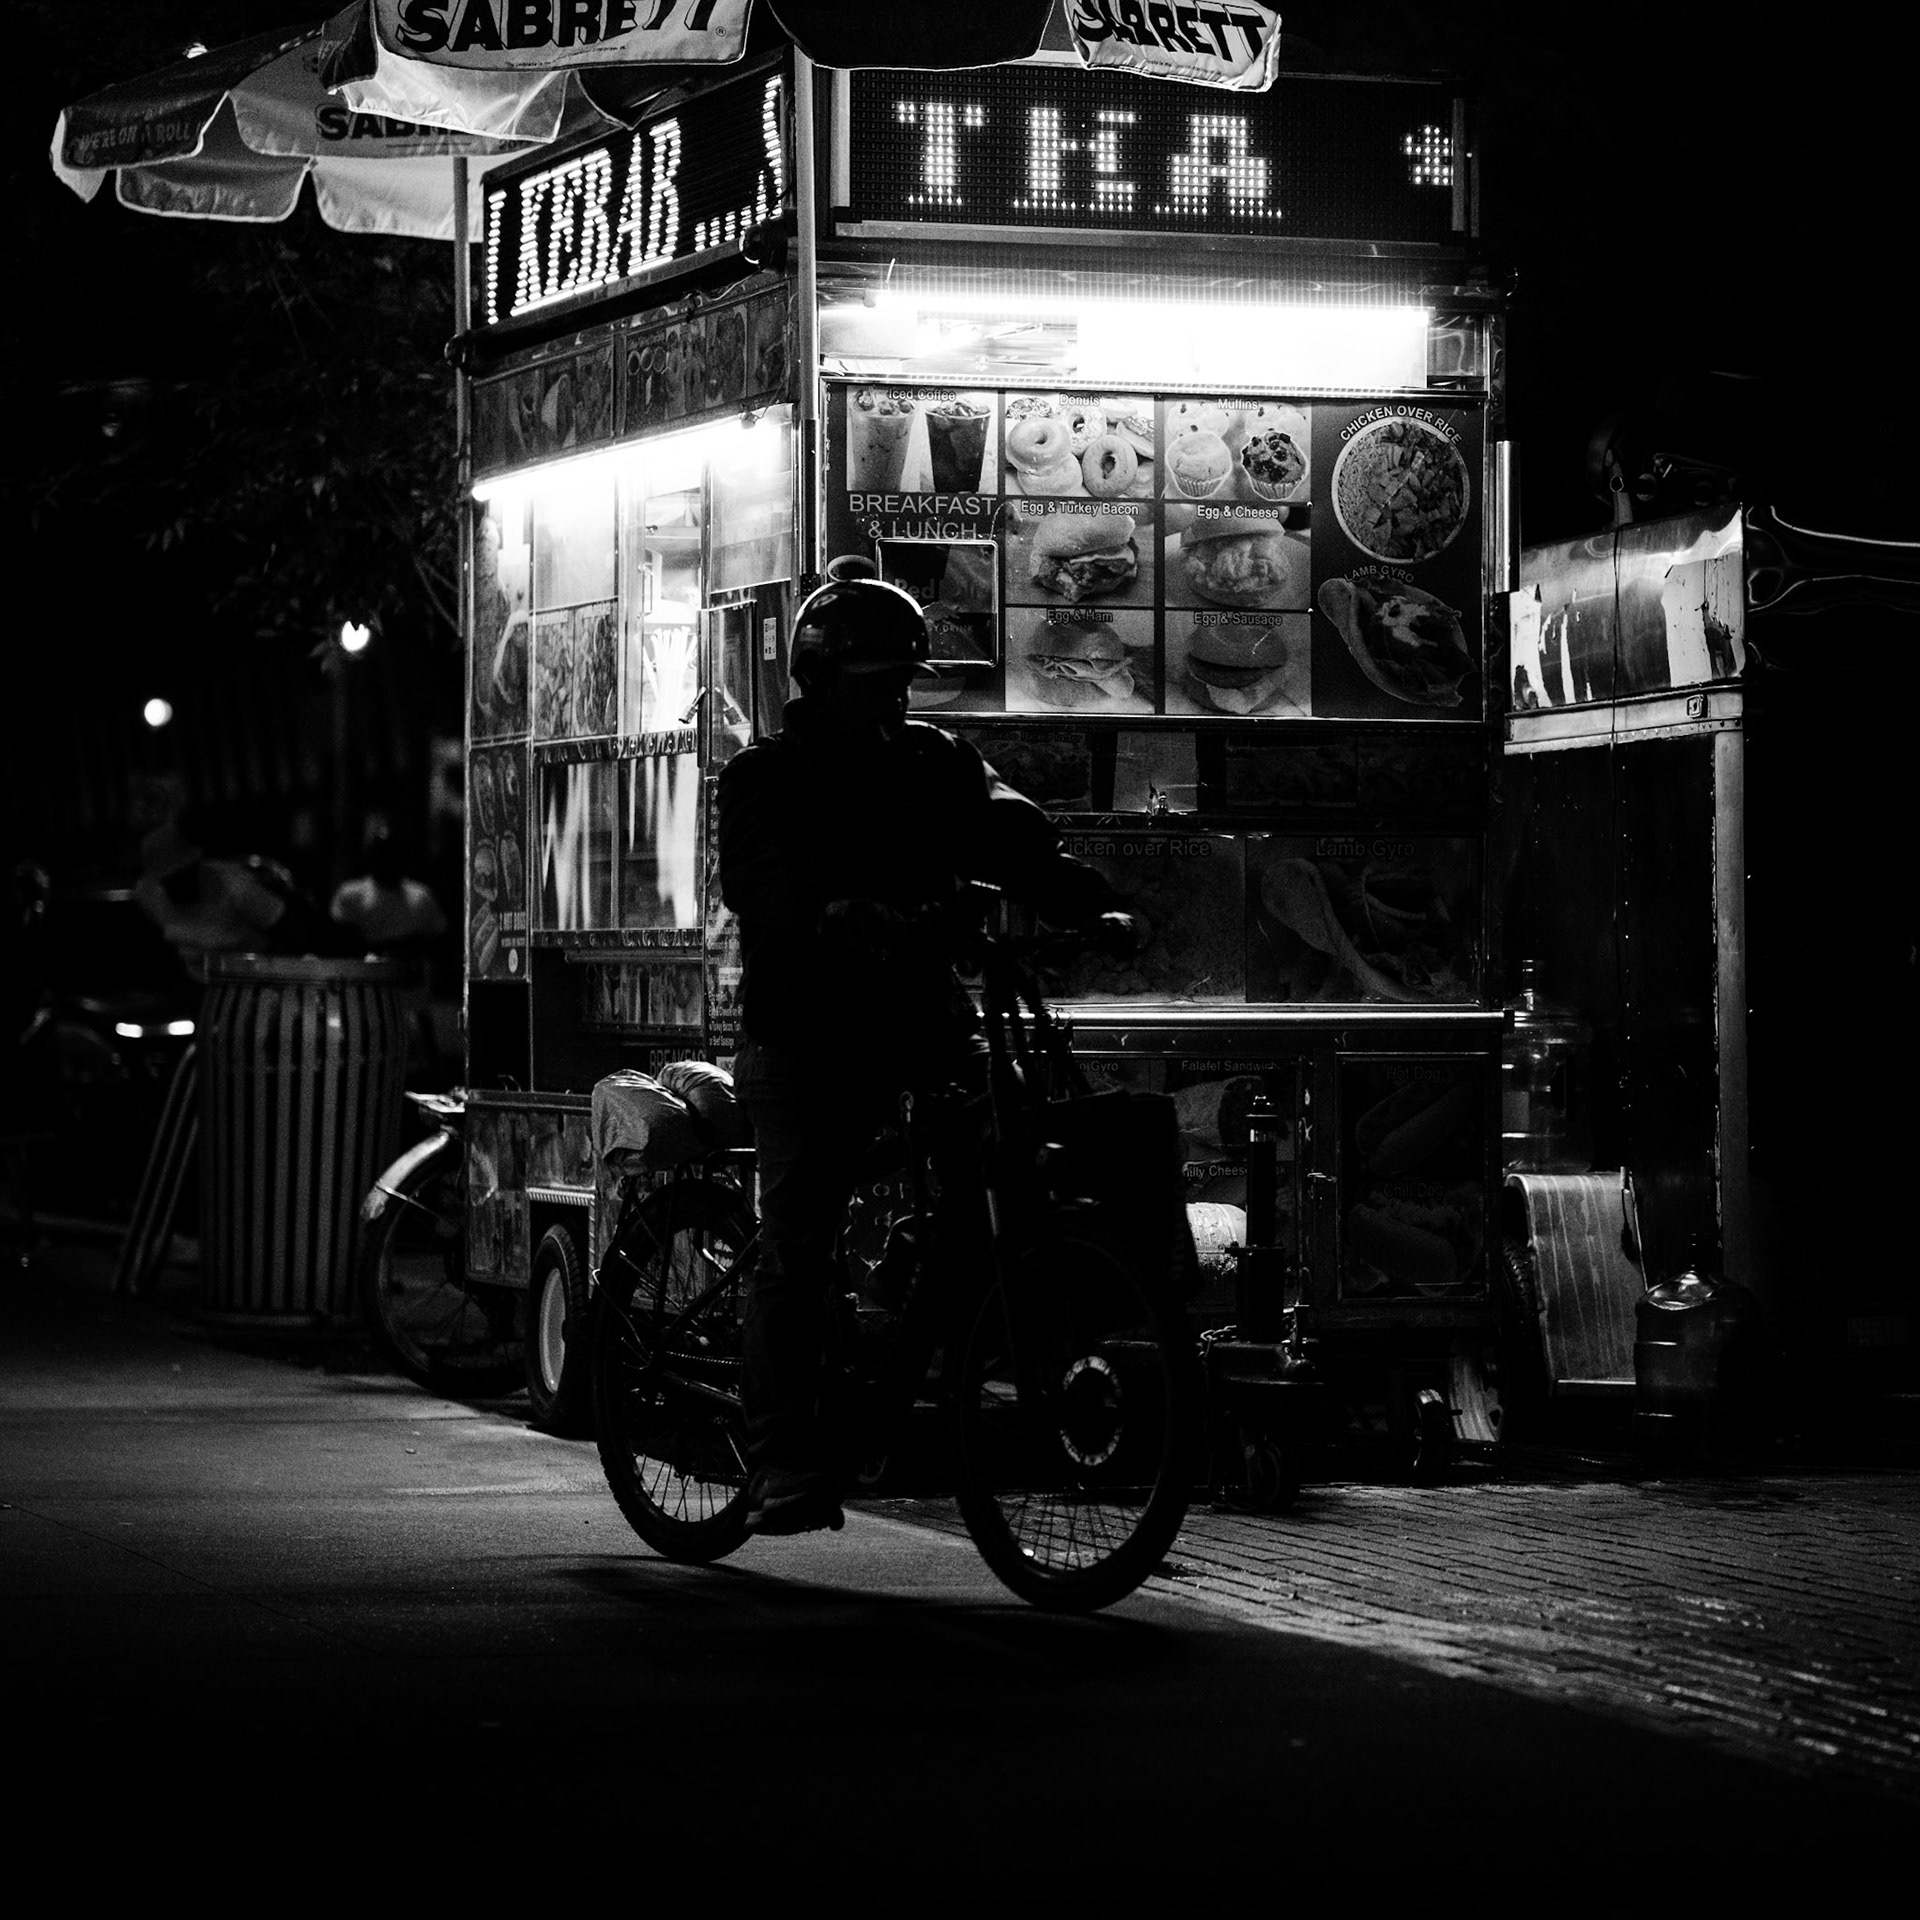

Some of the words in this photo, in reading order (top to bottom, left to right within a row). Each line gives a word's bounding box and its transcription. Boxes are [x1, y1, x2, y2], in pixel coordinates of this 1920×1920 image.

[888, 388, 914, 401] Iced
[918, 389, 956, 401] Coffee
[1060, 393, 1100, 406] Donuts
[1218, 398, 1258, 410] Muffins
[1340, 405, 1393, 442] CHICKEN
[1396, 404, 1434, 424] OVER
[1433, 416, 1463, 446] RICE
[850, 493, 997, 516] BREAKFAST
[1021, 501, 1043, 516] Egg
[1048, 502, 1056, 513] &
[1059, 502, 1098, 516] Turkey
[1102, 503, 1139, 515] Bacon
[1197, 505, 1220, 519] Egg
[1224, 506, 1232, 518] &
[1236, 507, 1279, 519] Cheese
[868, 520, 883, 539] &
[892, 520, 977, 540] LUNCH
[1344, 564, 1378, 582] LAMB
[1381, 564, 1414, 583] GYRO
[1046, 609, 1070, 623] Egg
[1073, 610, 1082, 621] &
[1086, 610, 1113, 622] Ham
[1194, 612, 1217, 626] Egg
[1221, 613, 1229, 624] &
[1232, 613, 1282, 627] Sausage
[1062, 840, 1116, 857] icken
[1122, 844, 1166, 857] over
[1170, 840, 1211, 857] Rice
[1315, 839, 1365, 857] Lamb
[1372, 840, 1416, 861] Gyro
[1090, 1060, 1119, 1074] Gyro
[1181, 1060, 1220, 1072] Falafel
[1224, 1060, 1278, 1073] Sandwich
[1386, 1065, 1409, 1081] Hot
[1414, 1065, 1441, 1083] Dog
[1184, 1165, 1206, 1180] illy
[1417, 1182, 1444, 1200] Dog
